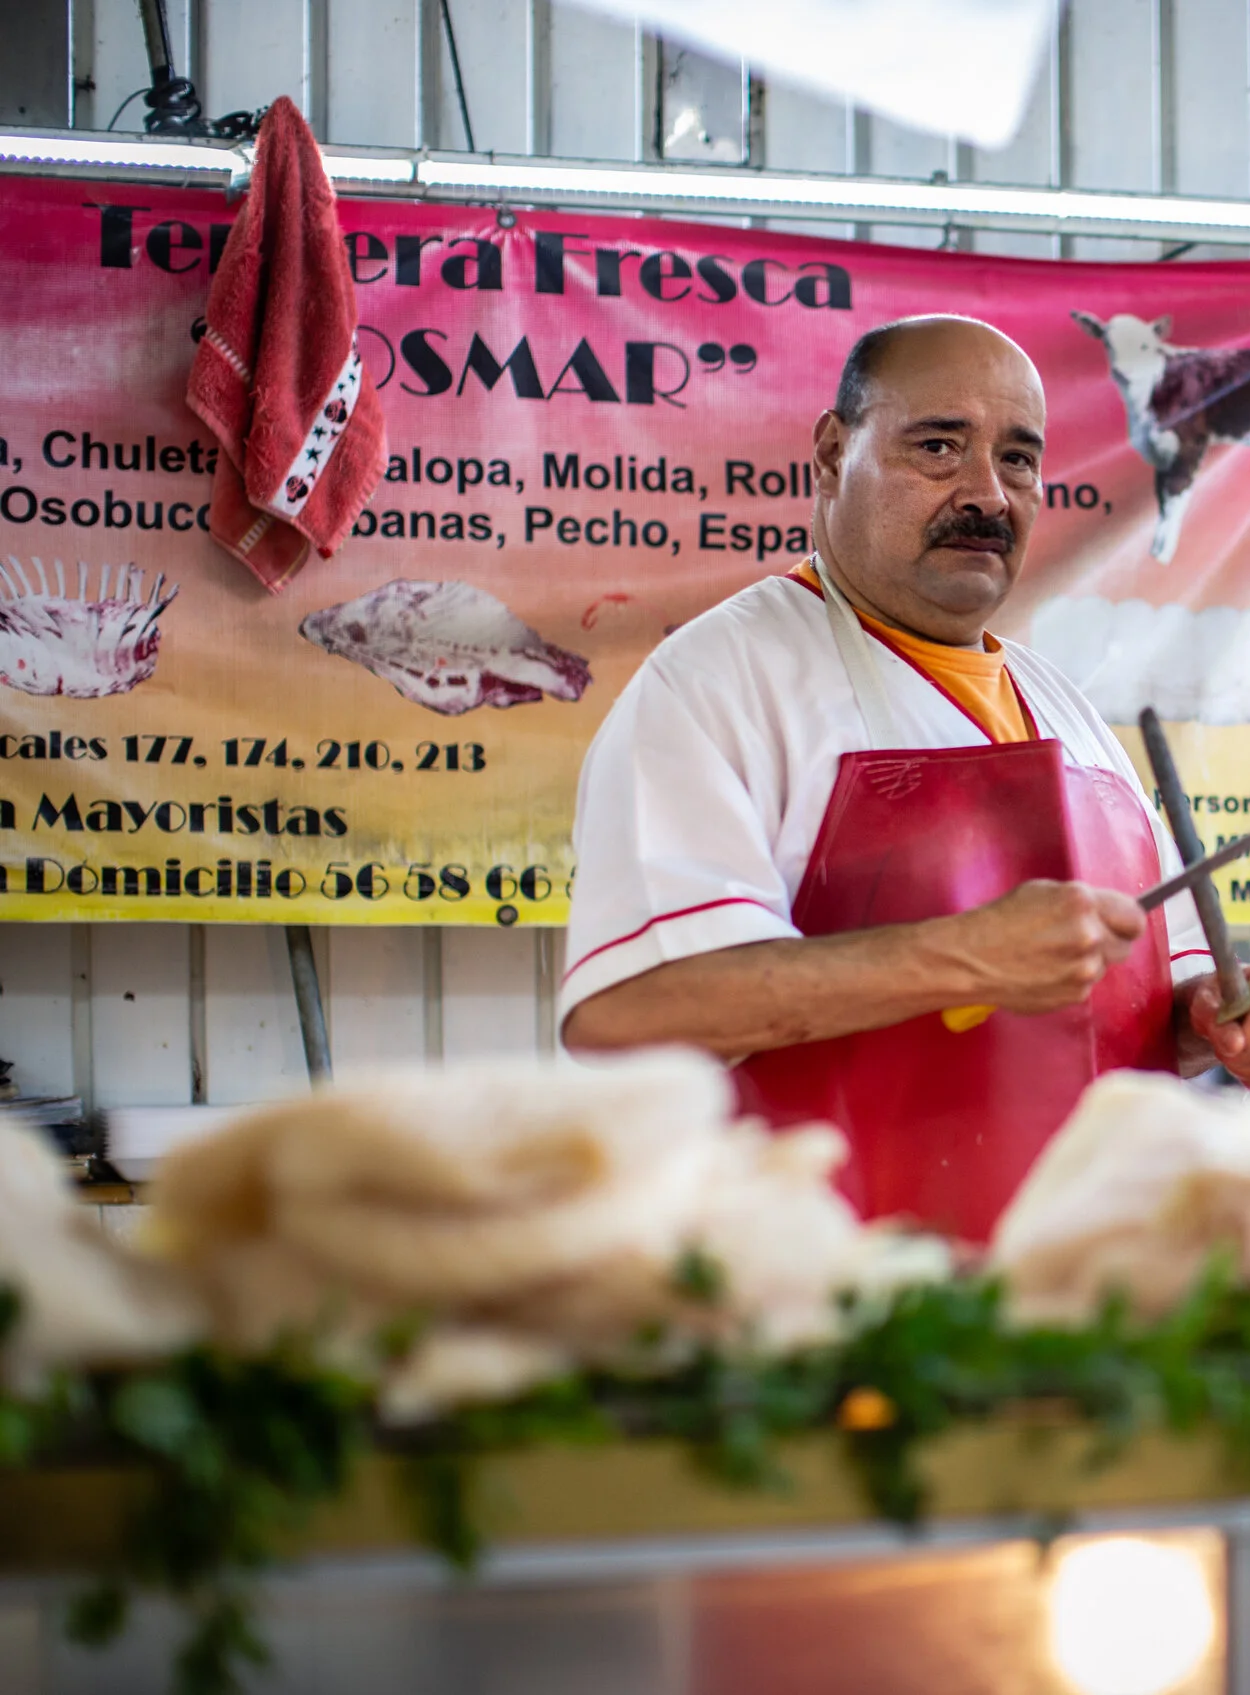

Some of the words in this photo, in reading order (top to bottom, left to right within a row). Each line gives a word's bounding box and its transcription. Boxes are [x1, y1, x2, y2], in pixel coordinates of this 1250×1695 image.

[535, 232, 853, 311] Fresca
[542, 452, 708, 500] Molida,
[524, 506, 681, 556] Pecho,
[415, 741, 487, 773] 213
[31, 792, 348, 838] Mayoristas
[25, 857, 307, 899] Domicilio
[320, 861, 390, 901] 56
[403, 862, 471, 902] 58
[485, 863, 552, 902] 66
